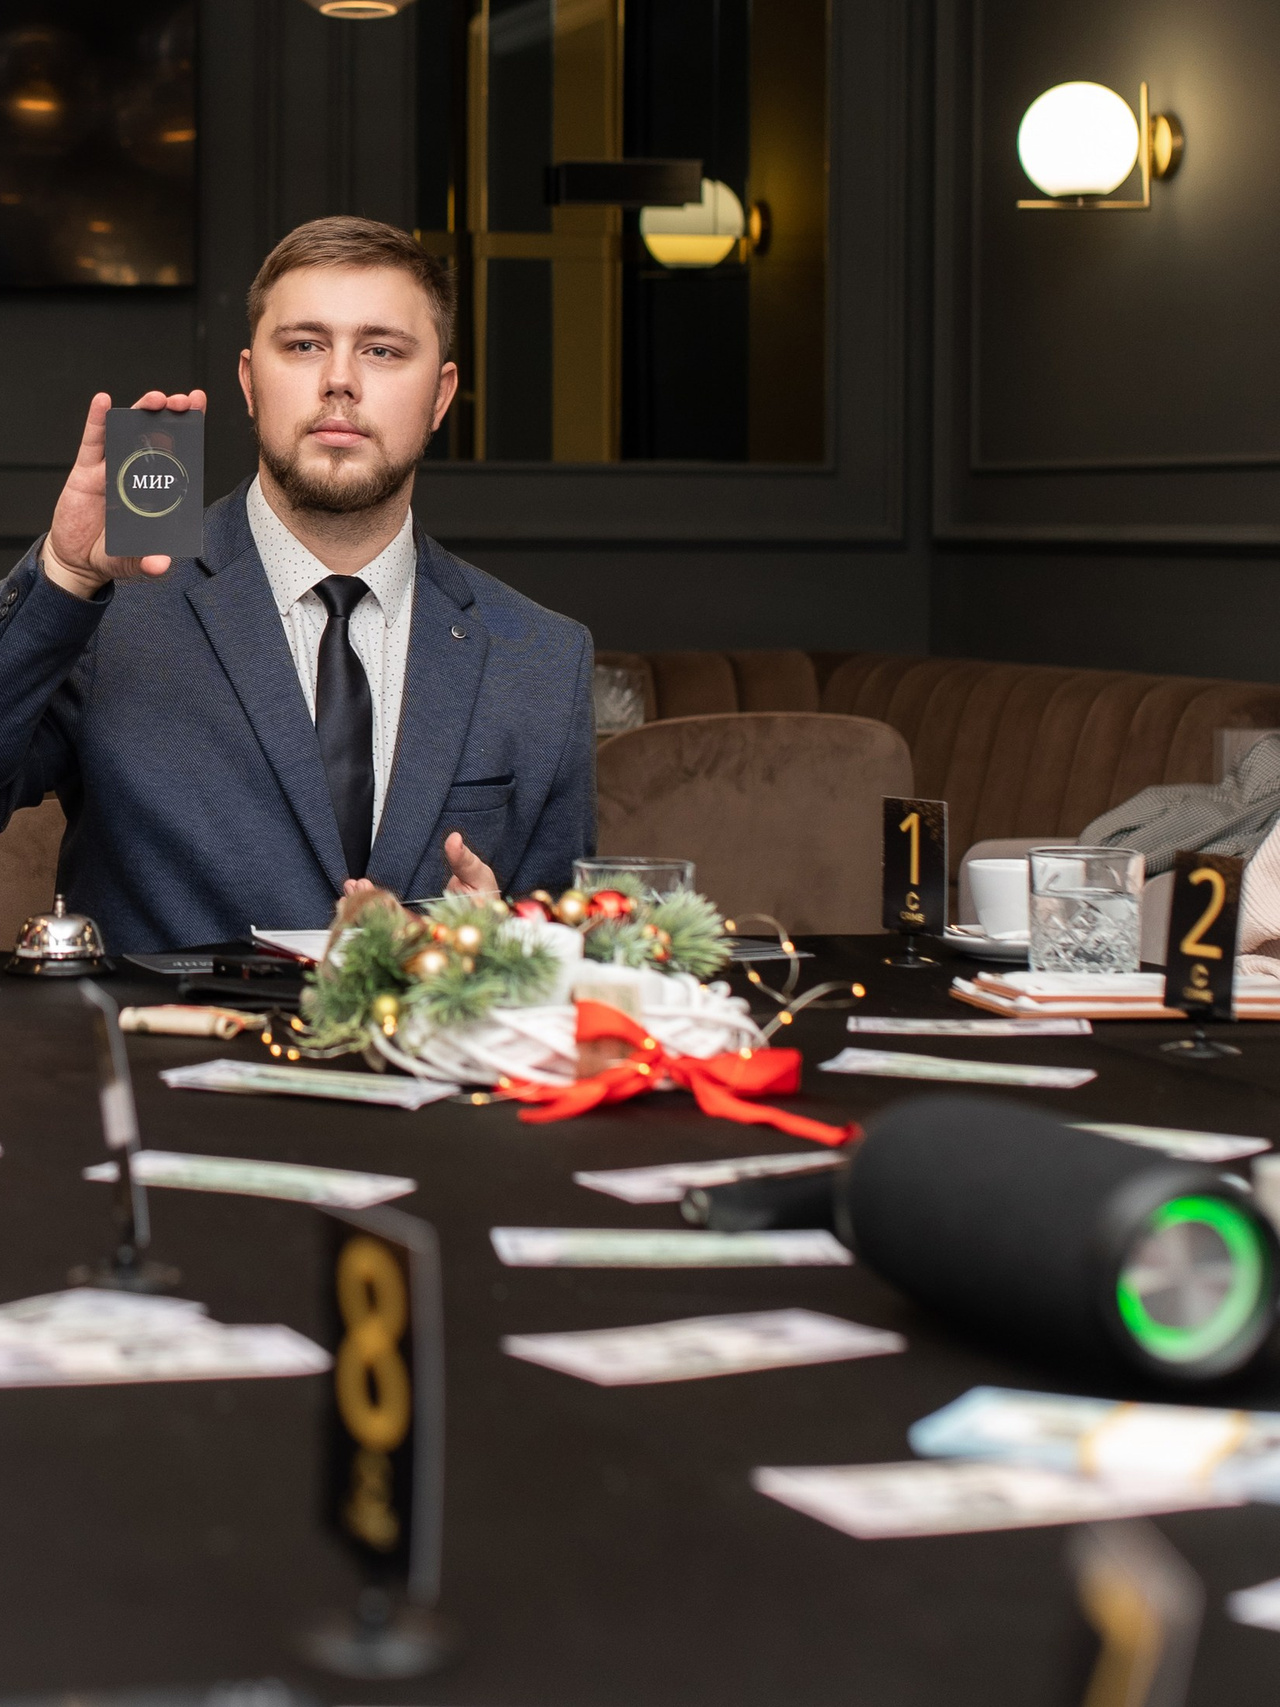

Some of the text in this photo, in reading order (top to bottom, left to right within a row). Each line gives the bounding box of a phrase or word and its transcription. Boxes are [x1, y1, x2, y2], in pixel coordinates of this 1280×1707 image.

[132, 474, 175, 490] МИР
[898, 812, 921, 886] 1
[1179, 867, 1226, 960] 2
[335, 1233, 412, 1454] 8
